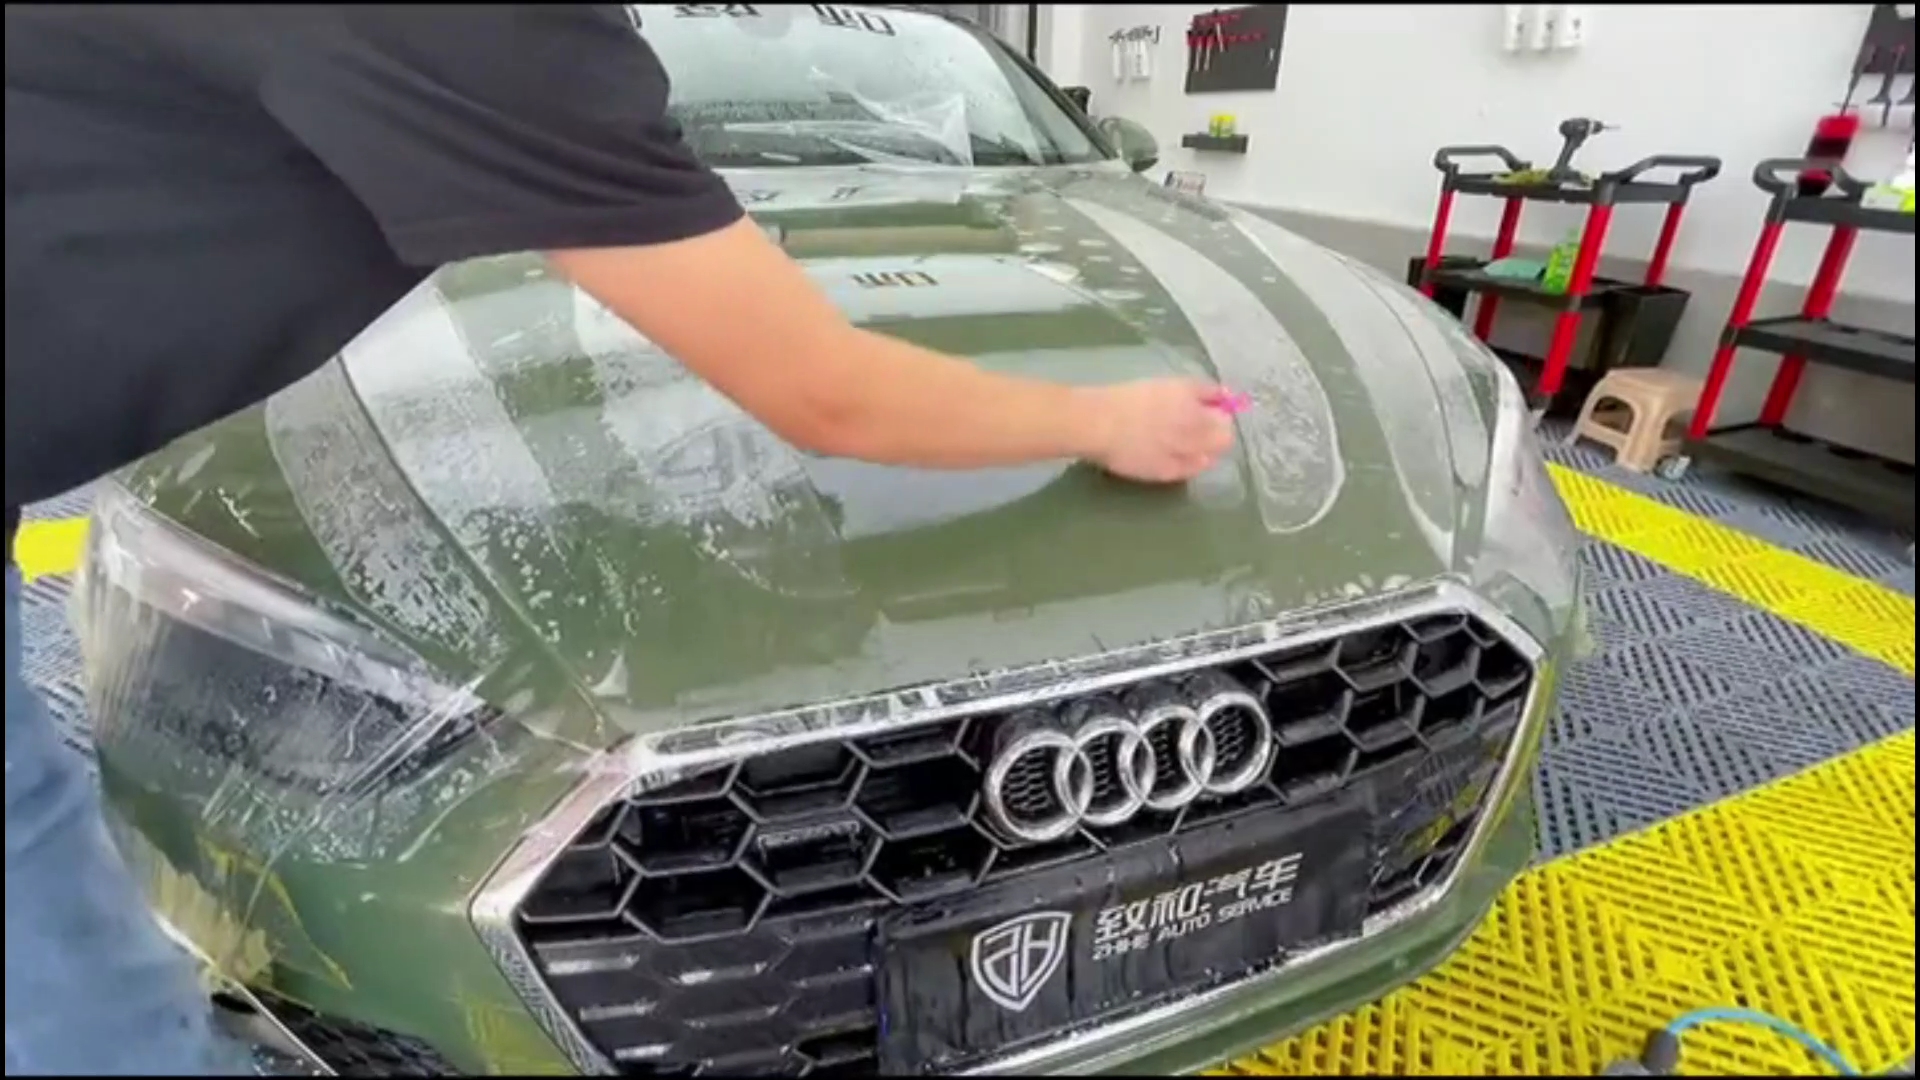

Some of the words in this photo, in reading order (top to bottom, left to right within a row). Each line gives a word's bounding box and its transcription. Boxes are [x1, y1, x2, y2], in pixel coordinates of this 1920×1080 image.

[1094, 852, 1303, 944] 致和汽车
[1156, 911, 1211, 943] AUTO
[1216, 885, 1294, 924] SERVICE
